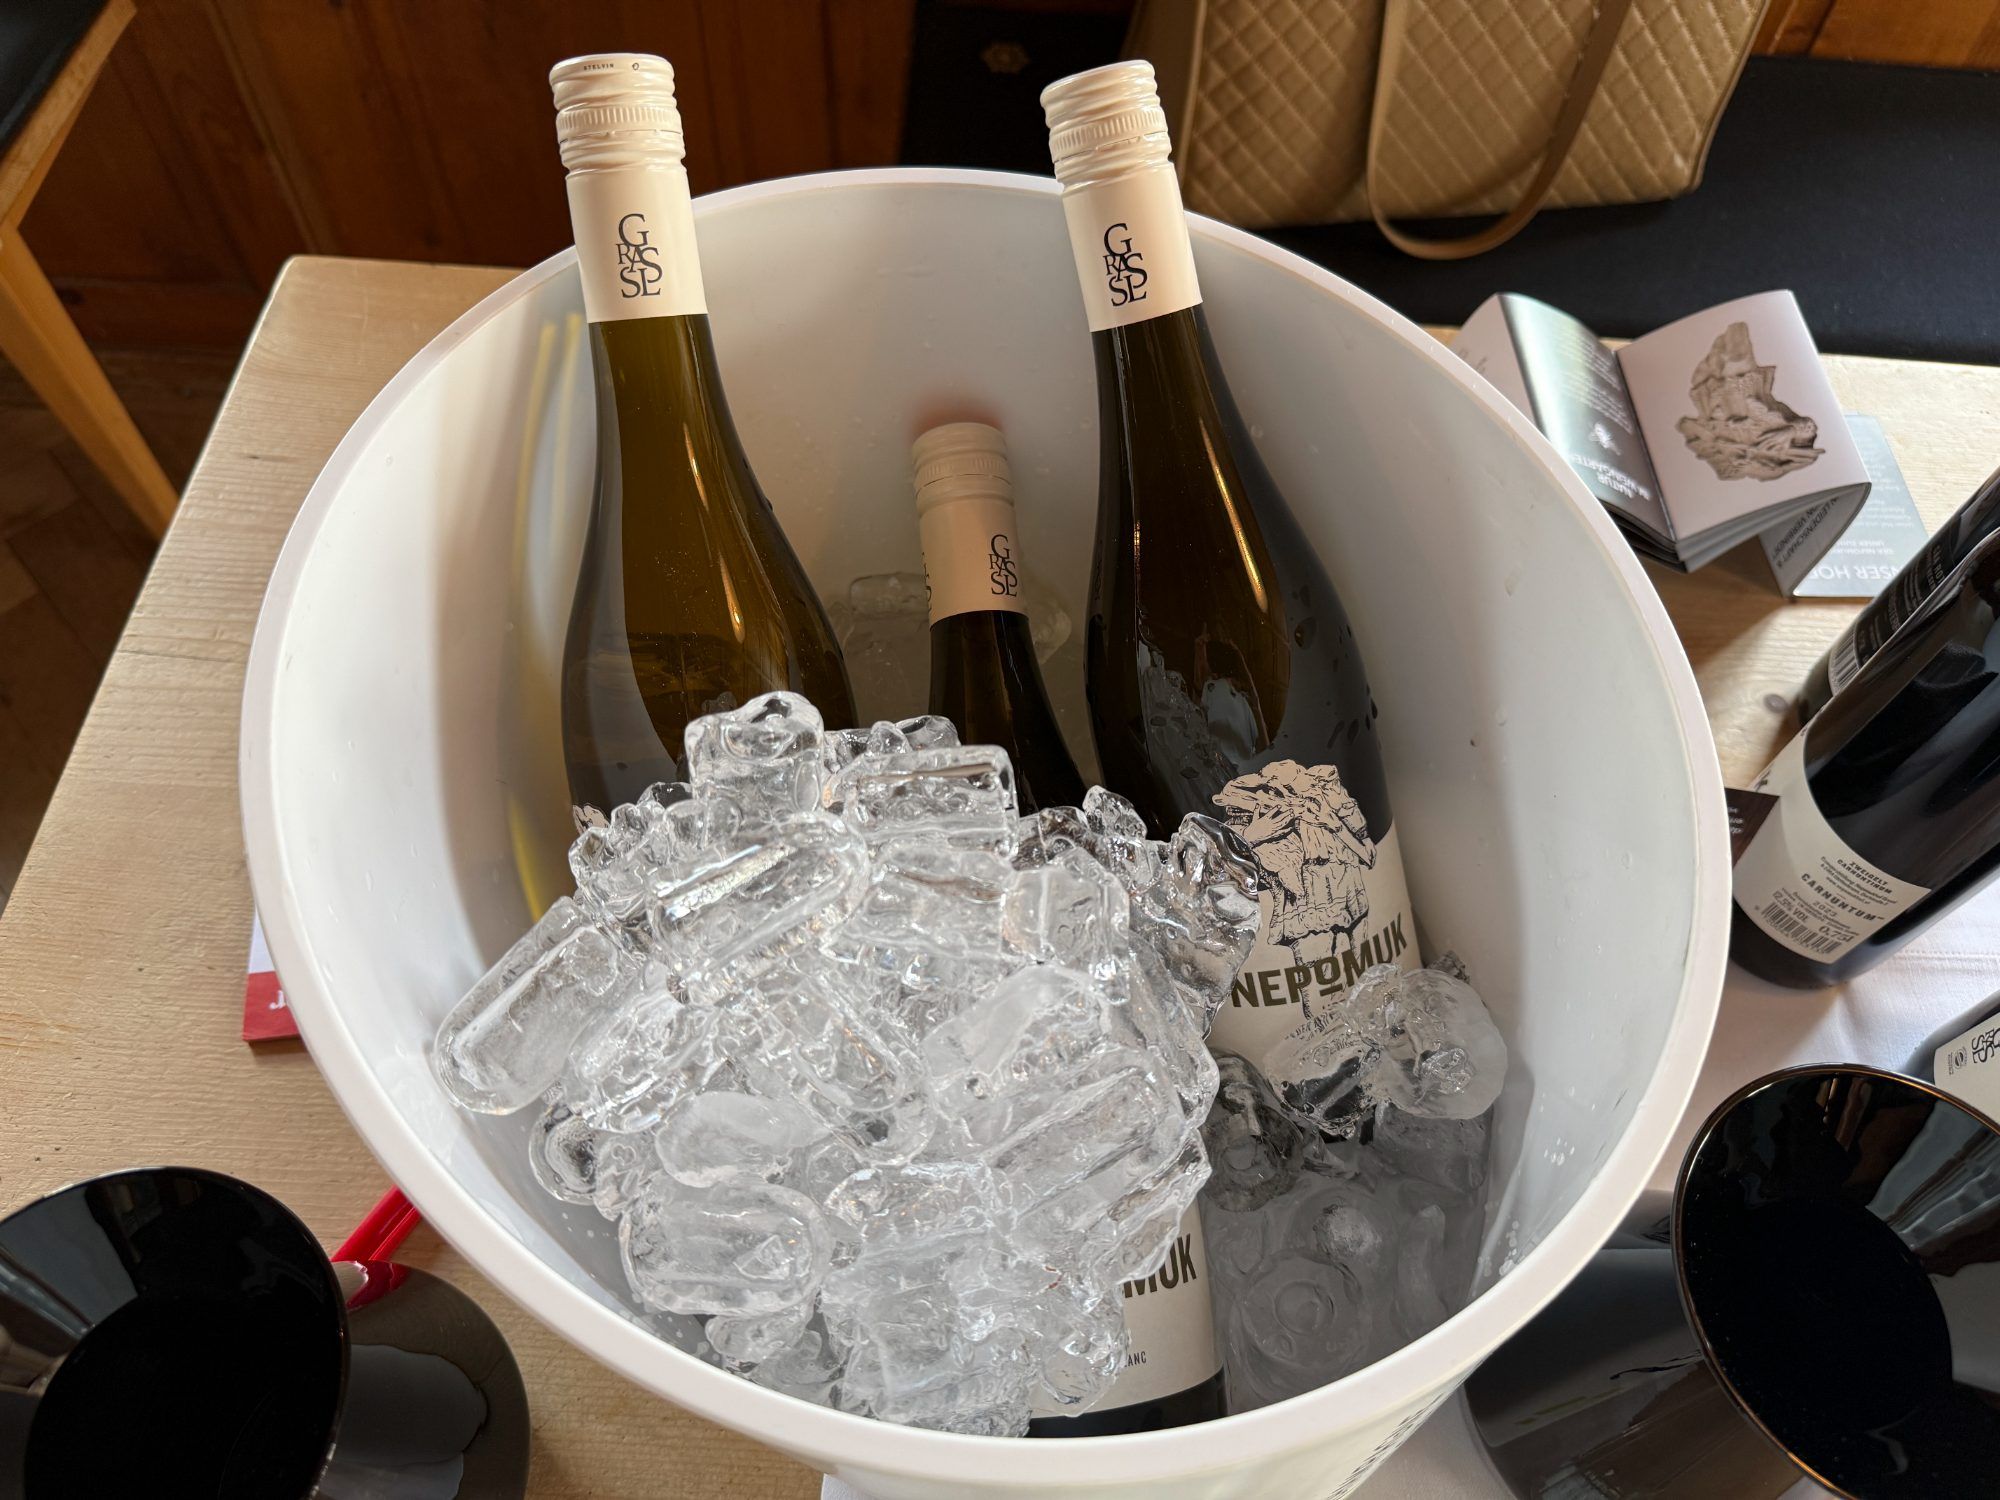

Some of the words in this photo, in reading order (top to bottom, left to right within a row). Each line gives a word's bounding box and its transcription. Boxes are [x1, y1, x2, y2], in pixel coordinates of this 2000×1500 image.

[583, 63, 614, 71] STELVIN
[1855, 565, 1901, 580] NSER
[1801, 873, 1876, 920] CARNUNTUM
[1230, 912, 1408, 1008] NEPOMUK
